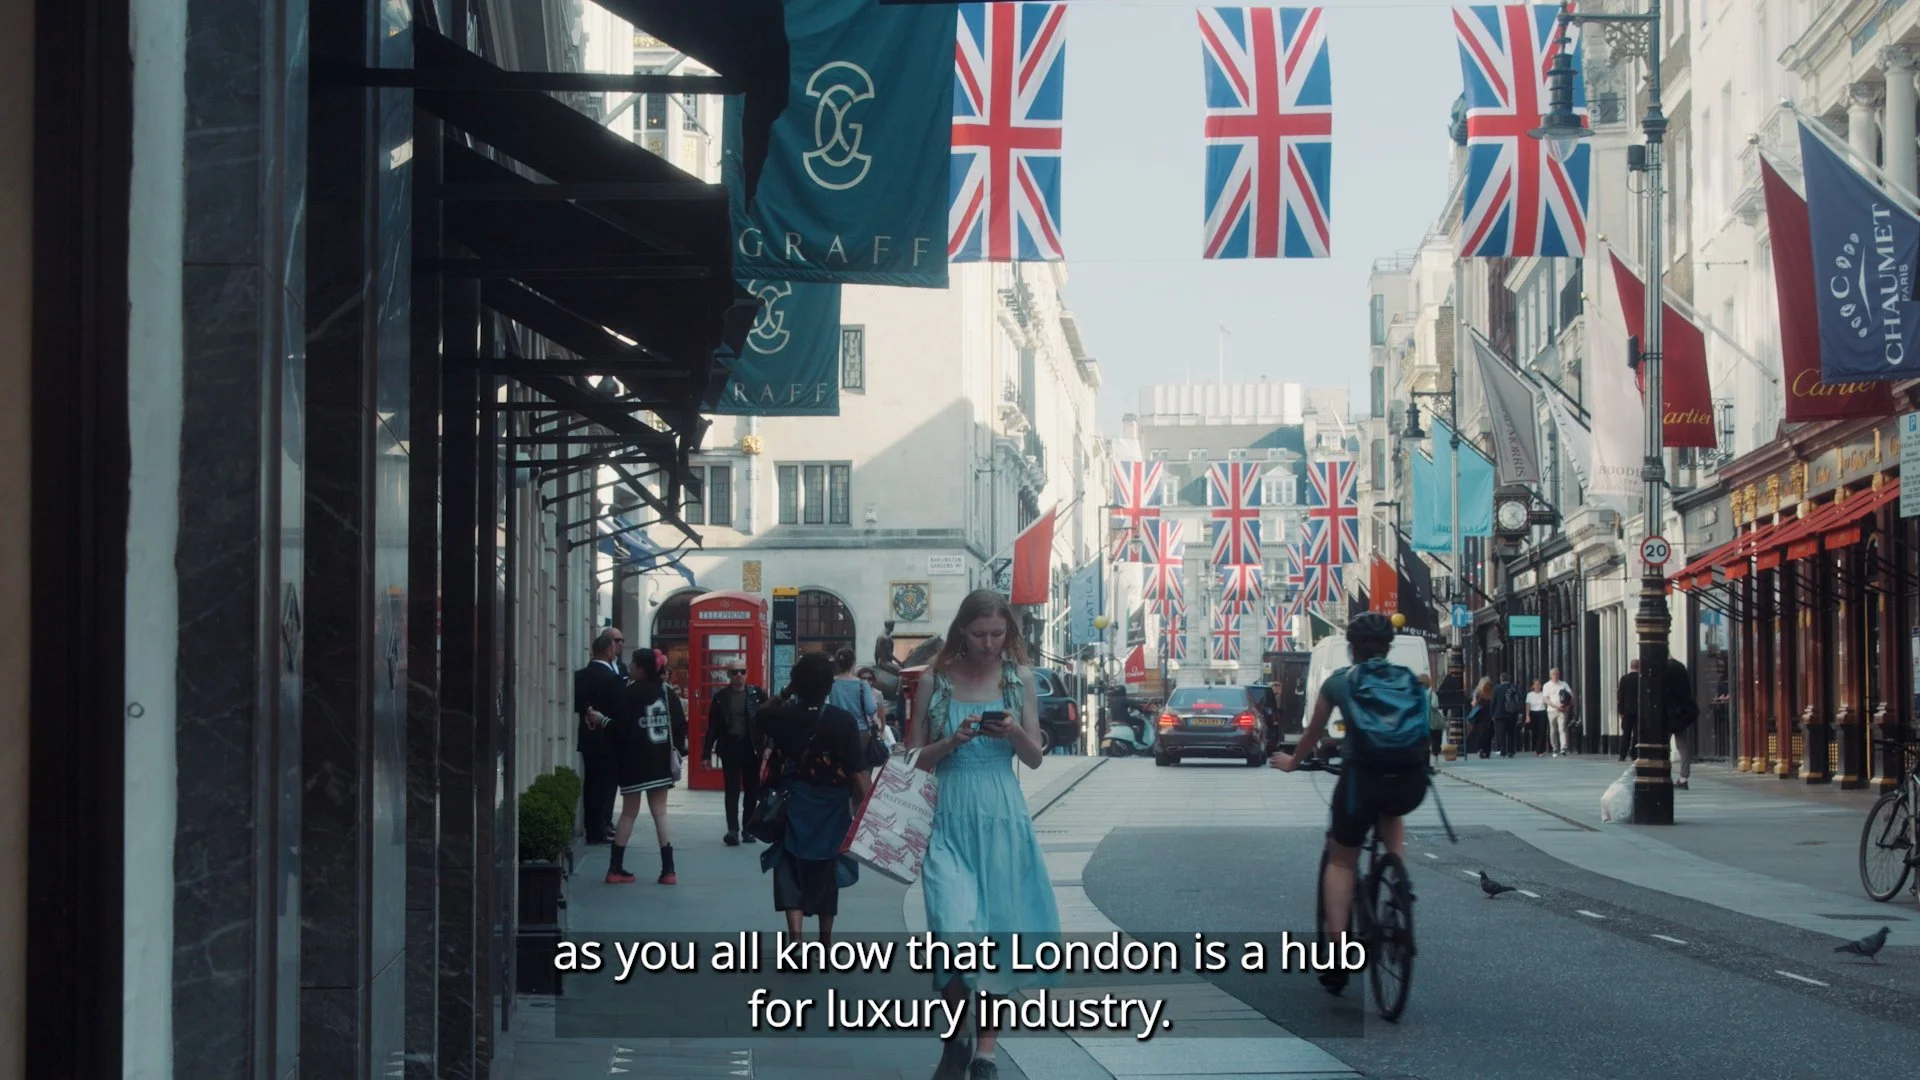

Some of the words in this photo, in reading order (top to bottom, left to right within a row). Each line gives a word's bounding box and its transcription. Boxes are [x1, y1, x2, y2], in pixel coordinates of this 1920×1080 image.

[738, 227, 930, 266] GRAFF
[1871, 203, 1904, 366] CHAUMET
[1898, 263, 1911, 302] PARIS
[734, 382, 828, 402] RAFF
[1663, 402, 1711, 425] artier
[1599, 465, 1641, 477] BOODL
[1645, 544, 1667, 557] 20
[701, 611, 747, 619] TELEPHONE
[1085, 576, 1095, 638] CHATILA
